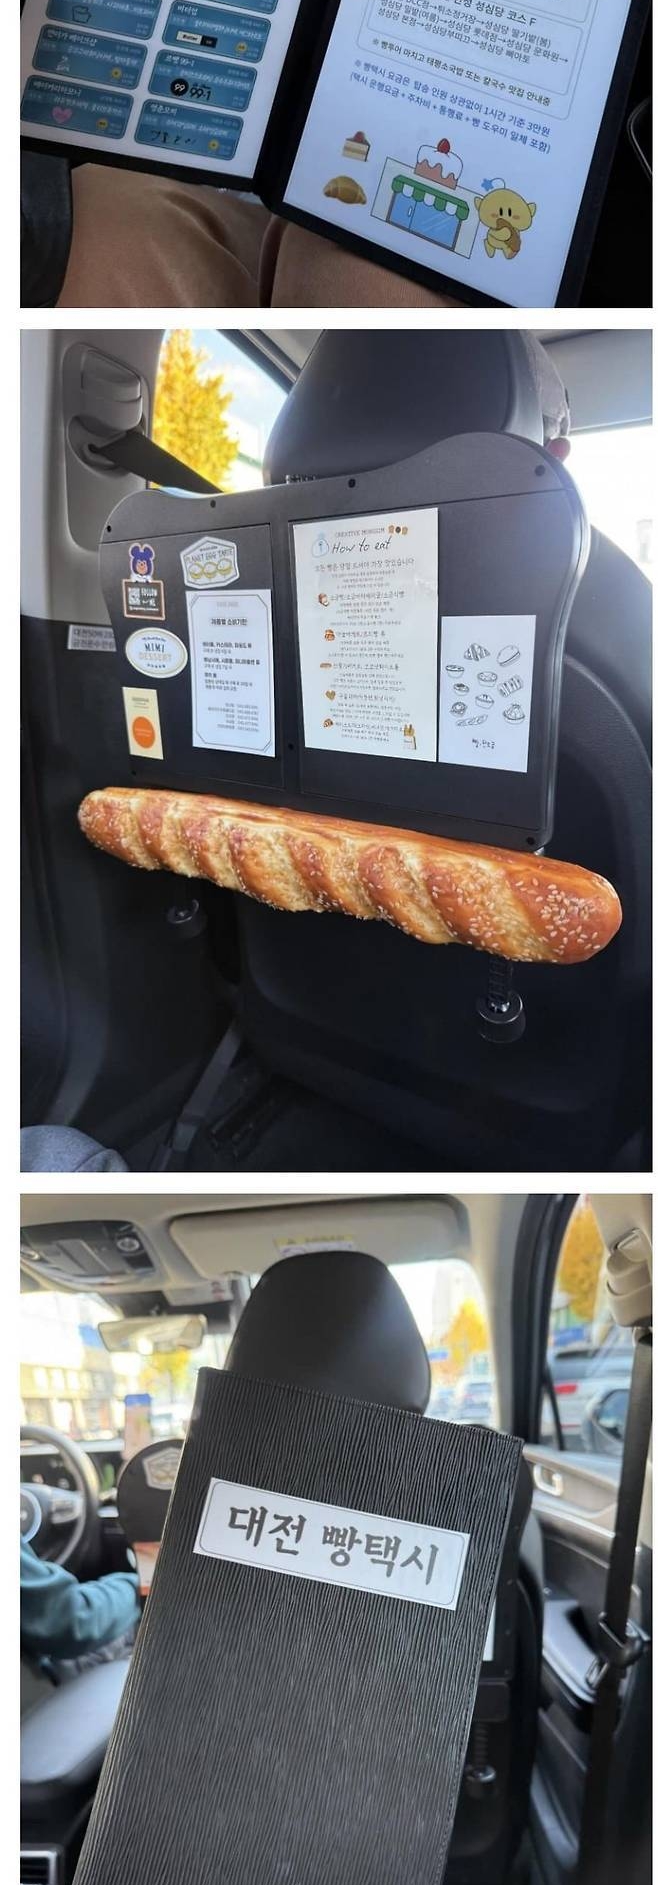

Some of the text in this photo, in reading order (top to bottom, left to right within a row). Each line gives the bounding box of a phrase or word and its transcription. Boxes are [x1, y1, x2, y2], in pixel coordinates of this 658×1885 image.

[475, 0, 504, 17] 성심당
[506, 10, 526, 25] 코스
[332, 535, 392, 554] How to eat
[139, 653, 172, 662] DESSERT
[144, 643, 165, 654] MIMI
[227, 1506, 439, 1585] 대전 빵택시
